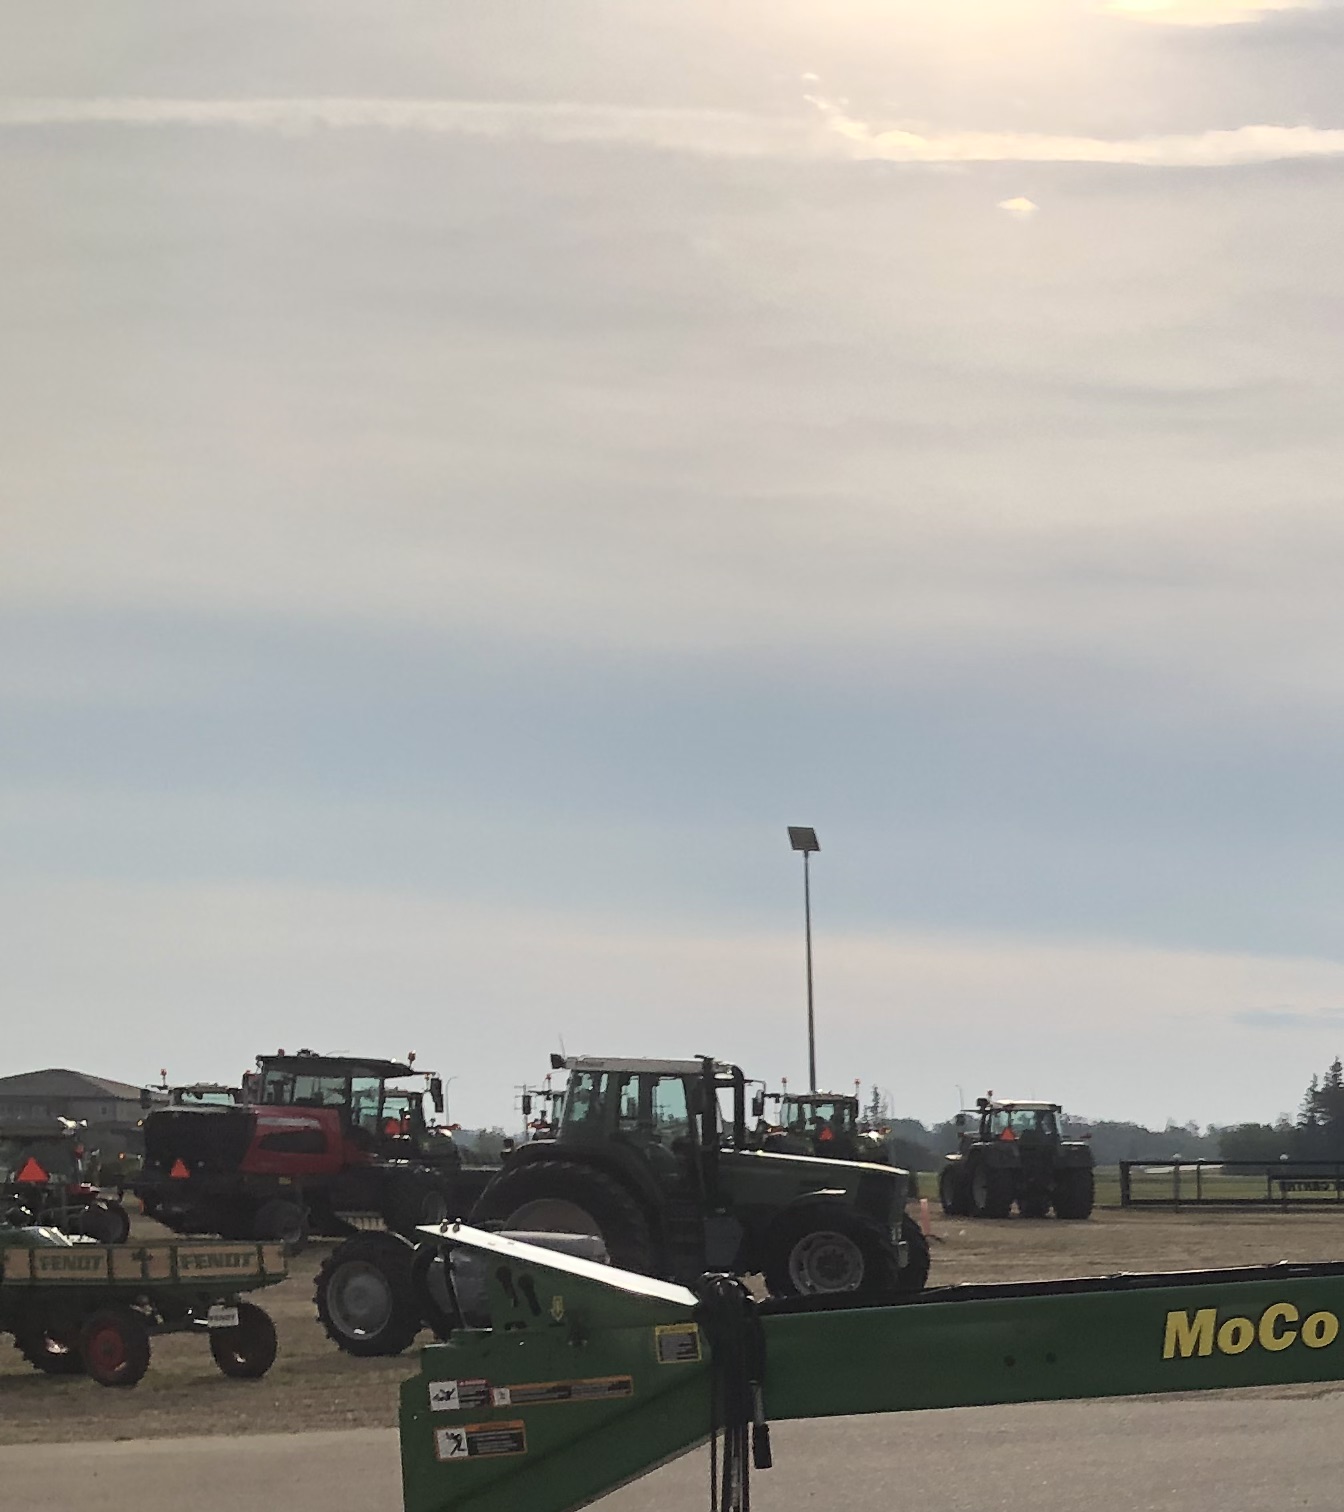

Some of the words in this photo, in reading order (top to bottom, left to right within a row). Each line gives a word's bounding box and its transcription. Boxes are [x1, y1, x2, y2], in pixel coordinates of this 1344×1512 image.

[39, 1254, 103, 1271] FENDT
[179, 1252, 256, 1270] FENDT
[1162, 1302, 1340, 1358] MoCo
